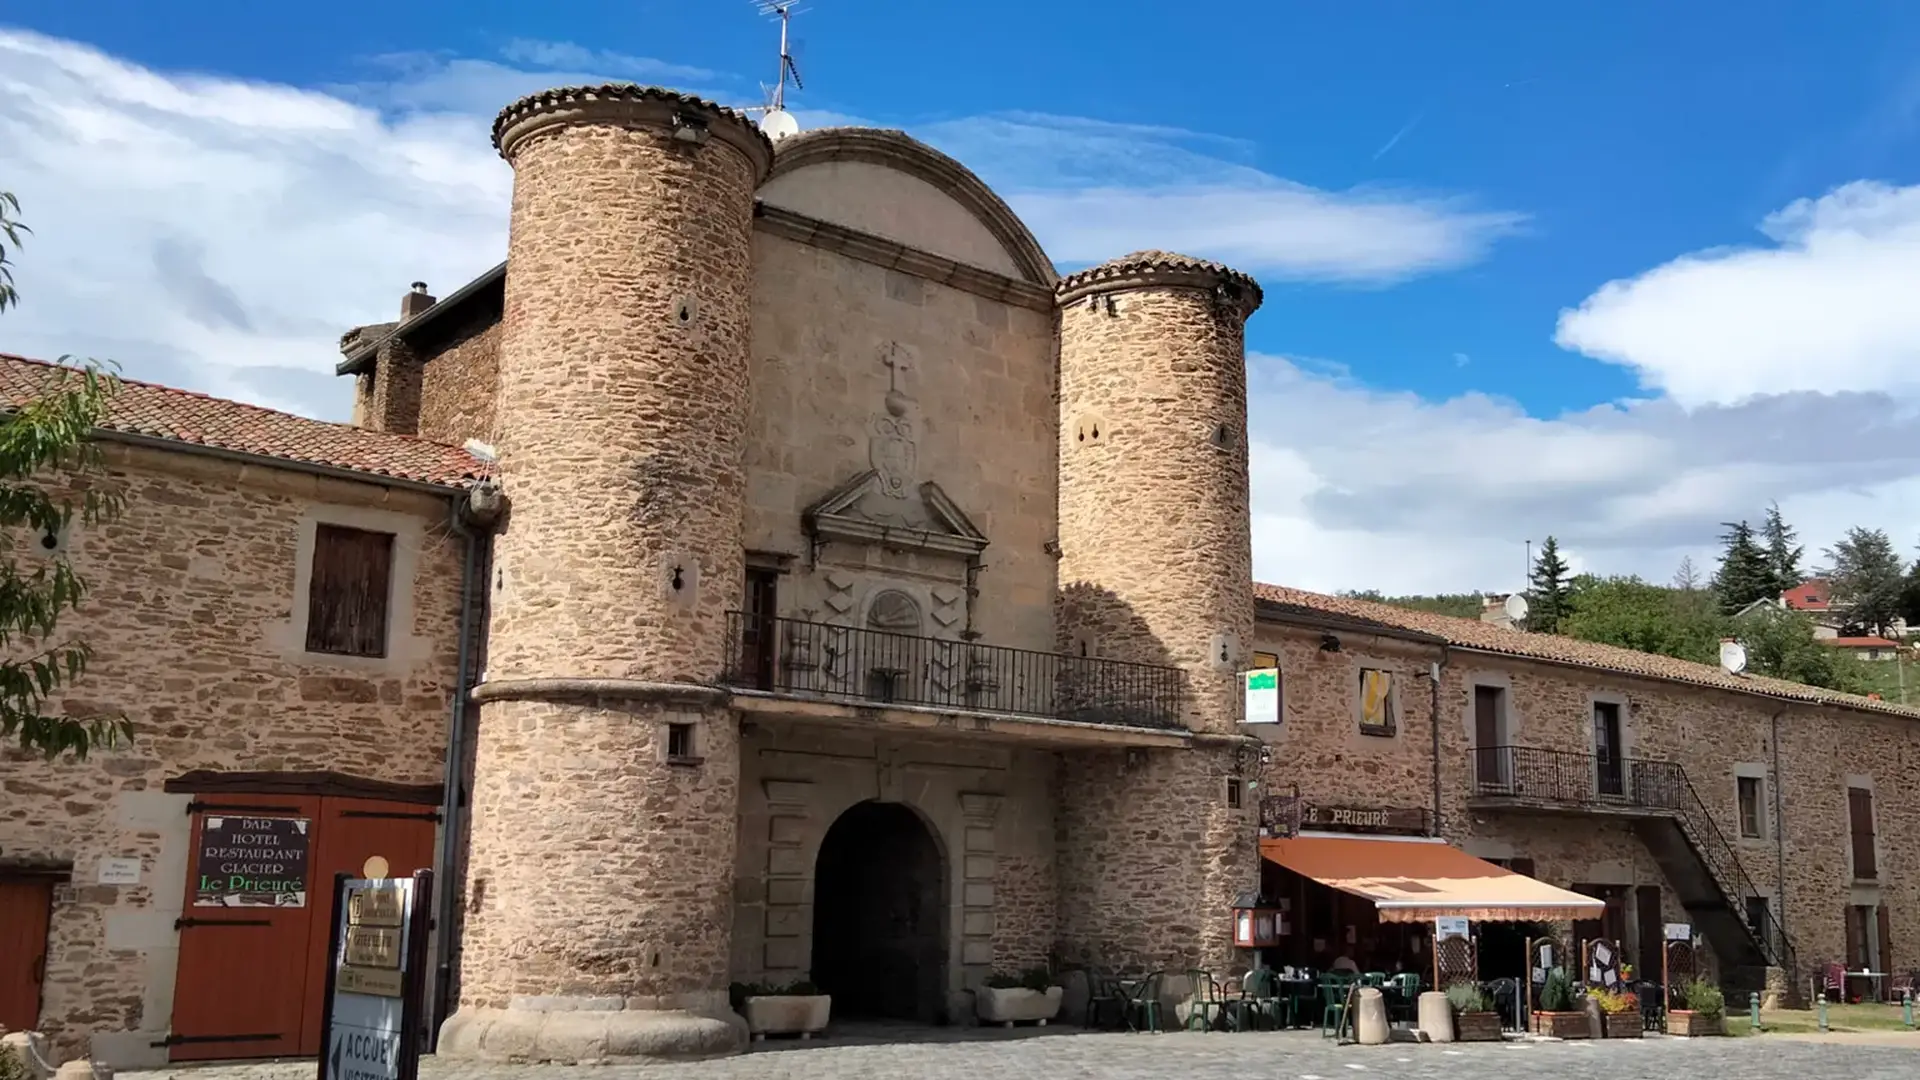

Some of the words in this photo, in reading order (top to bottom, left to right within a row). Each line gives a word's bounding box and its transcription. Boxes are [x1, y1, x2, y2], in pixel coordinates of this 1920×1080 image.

[242, 819, 272, 830] BAR
[232, 833, 280, 846] HOTEL
[205, 847, 303, 860] RESTAURANT
[220, 863, 284, 874] GLACIER
[200, 875, 222, 891] Le
[229, 875, 302, 891] Prieuré
